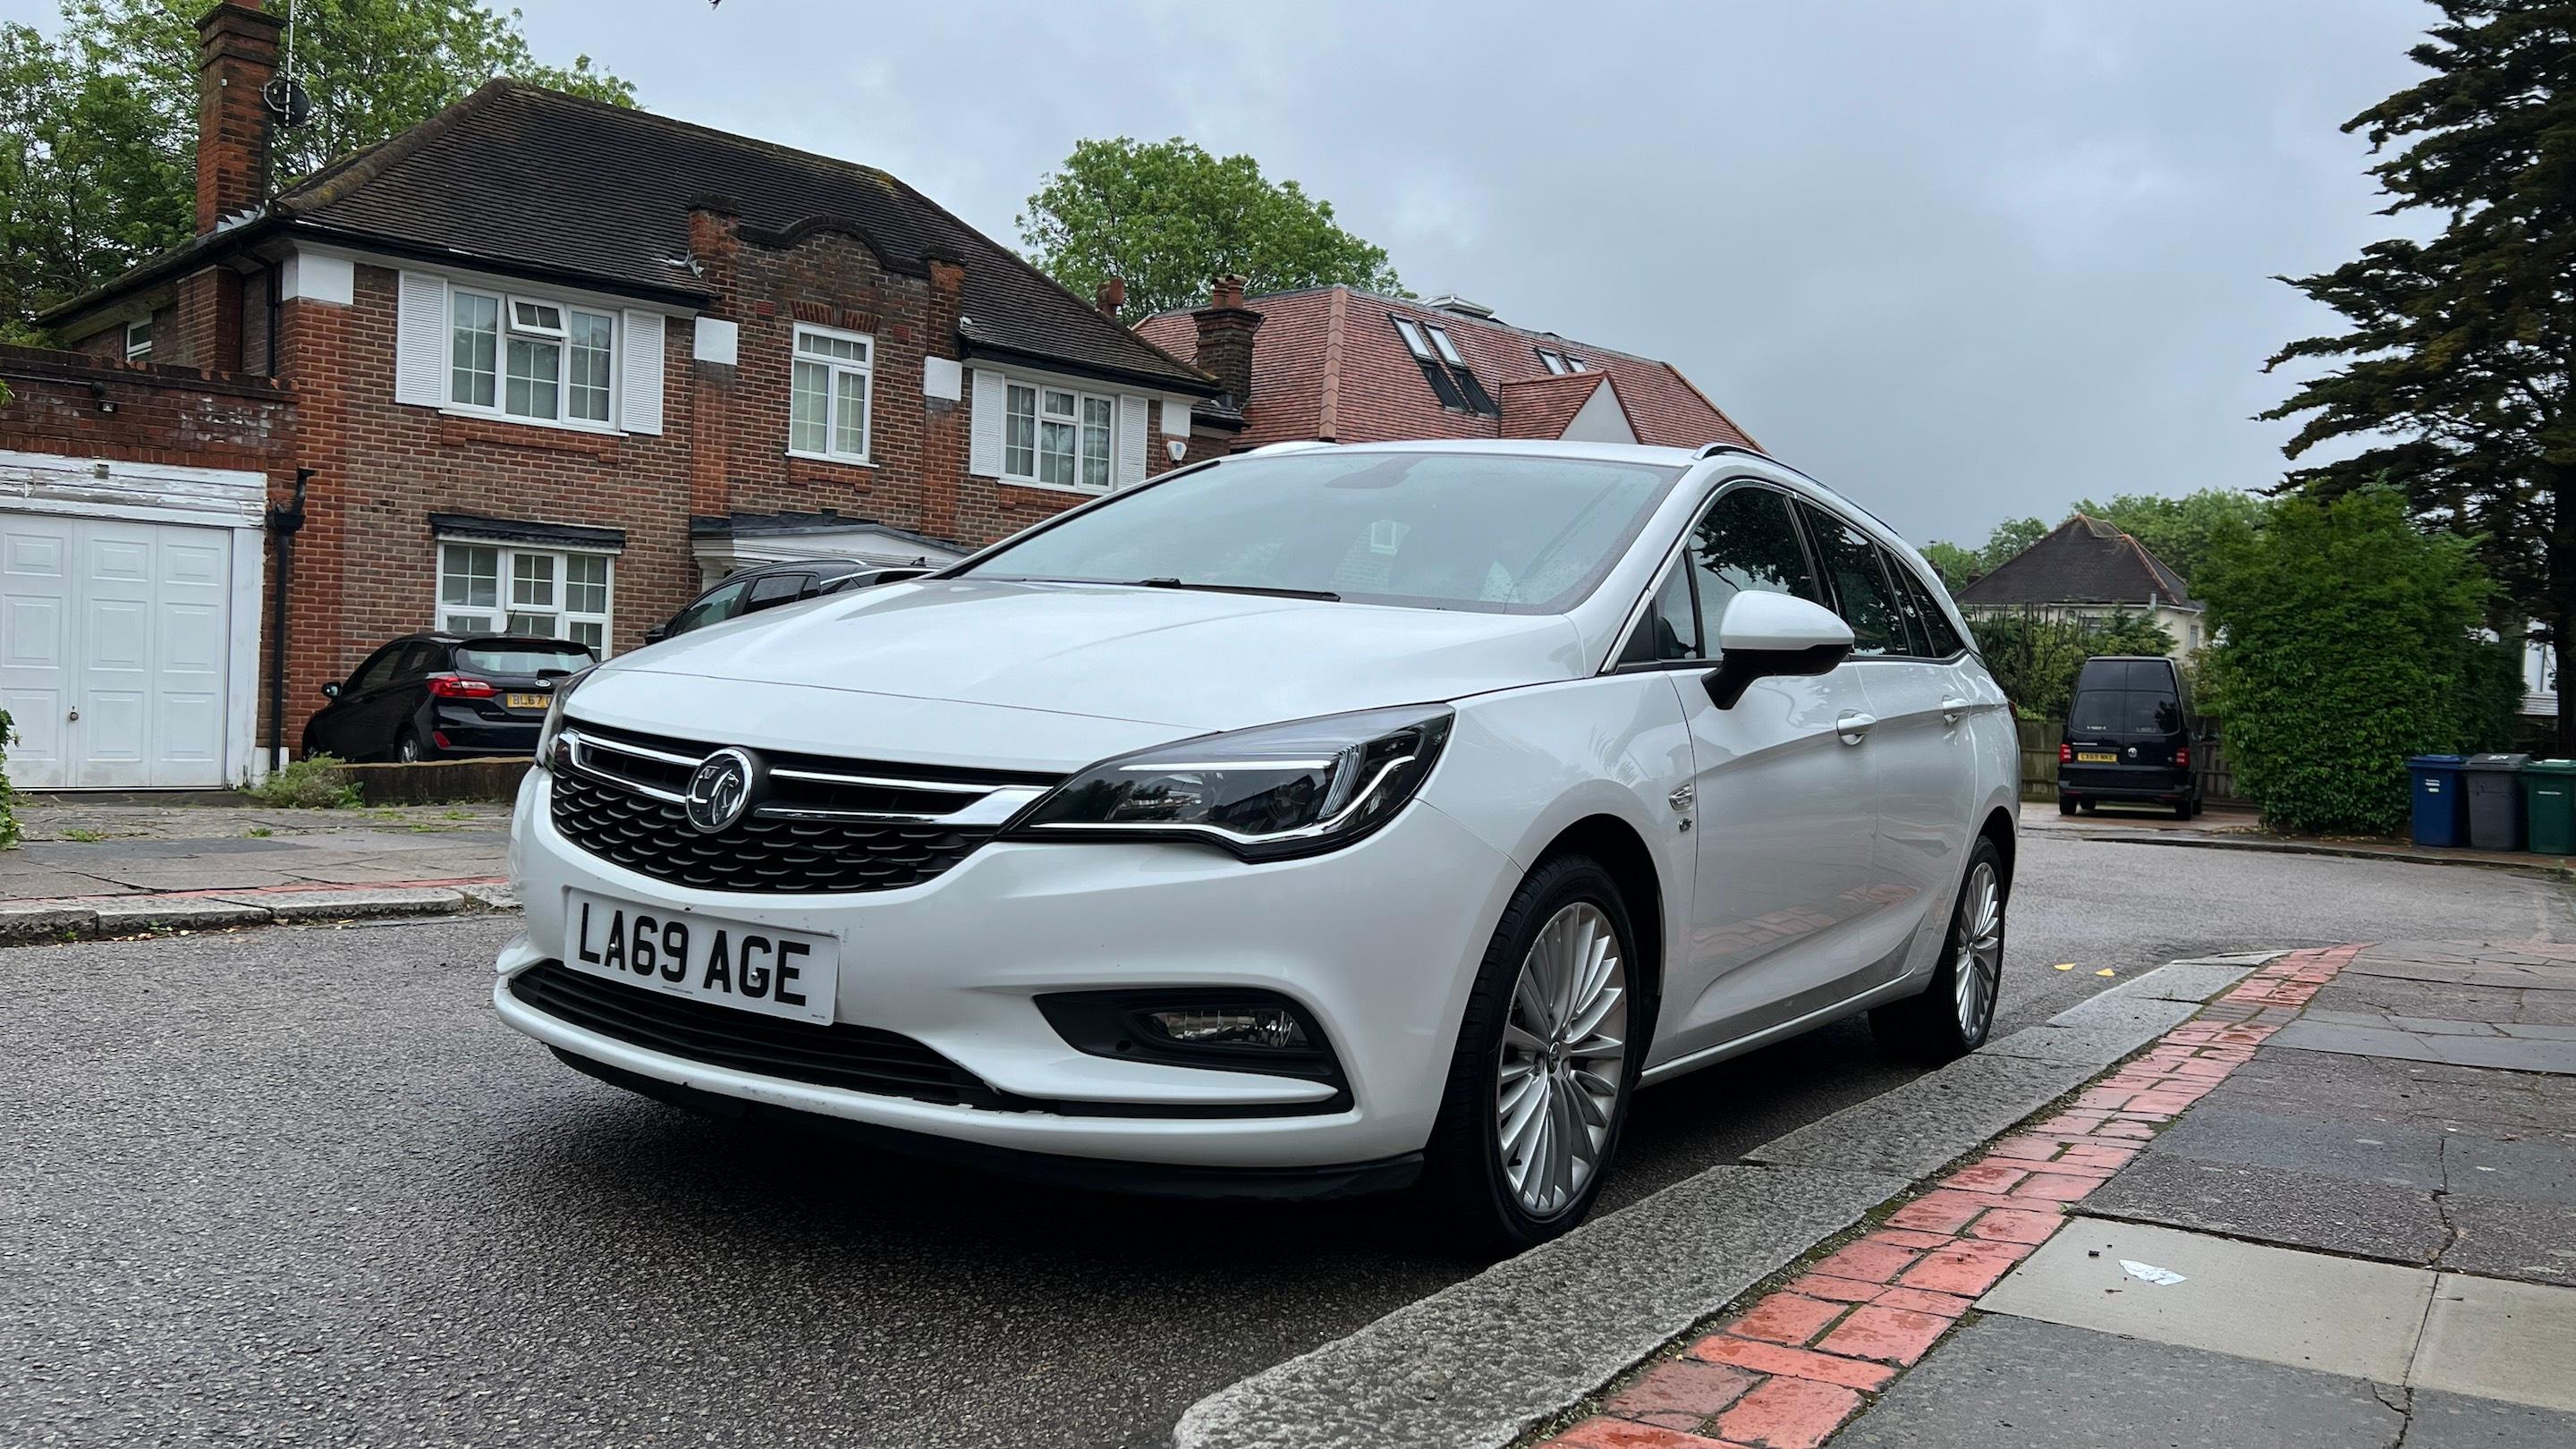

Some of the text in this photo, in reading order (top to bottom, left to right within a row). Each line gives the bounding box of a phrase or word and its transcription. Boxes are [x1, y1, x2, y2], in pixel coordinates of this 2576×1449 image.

[513, 694, 543, 705] BL67
[579, 902, 811, 1007] LA69 AGE
